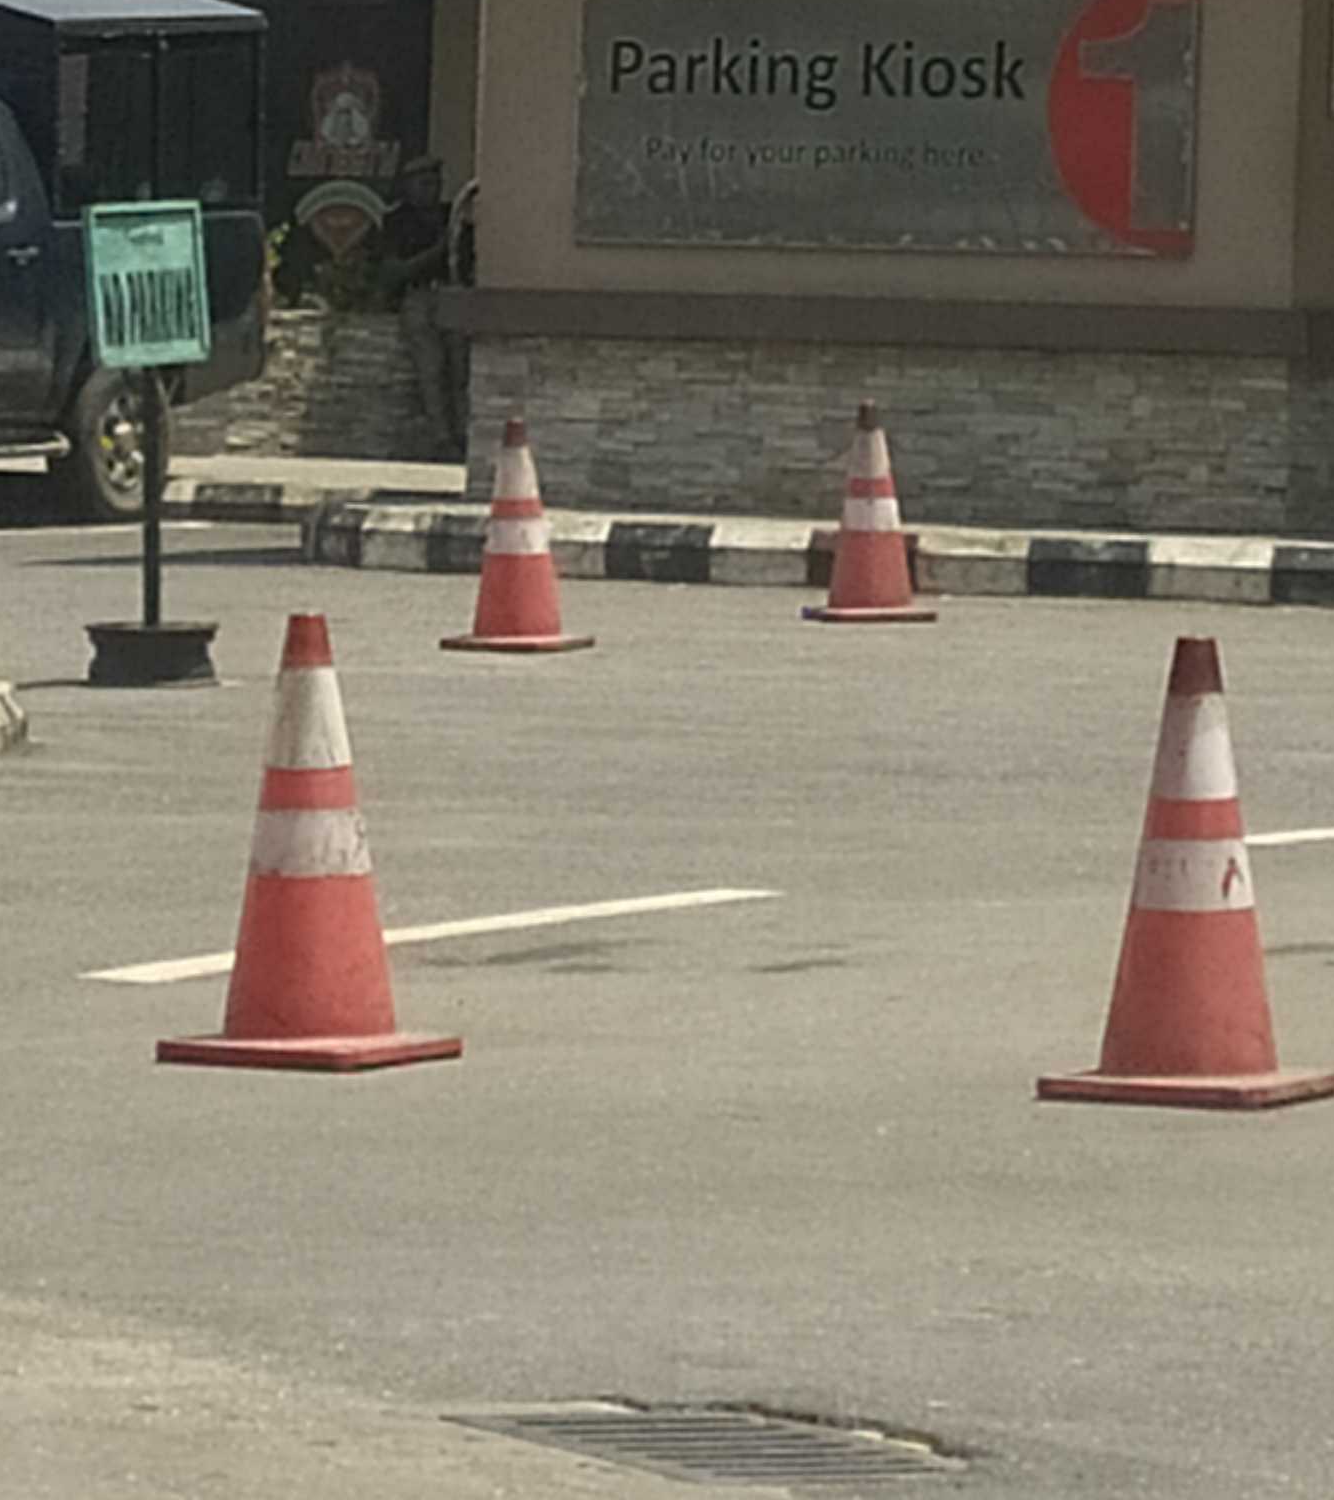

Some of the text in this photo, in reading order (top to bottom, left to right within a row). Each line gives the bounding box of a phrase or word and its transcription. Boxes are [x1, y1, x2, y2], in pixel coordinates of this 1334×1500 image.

[609, 37, 1026, 110] Parking Kiosk
[645, 136, 693, 166] Pay
[699, 136, 736, 162] for
[746, 142, 806, 168] your
[814, 138, 915, 170] parking
